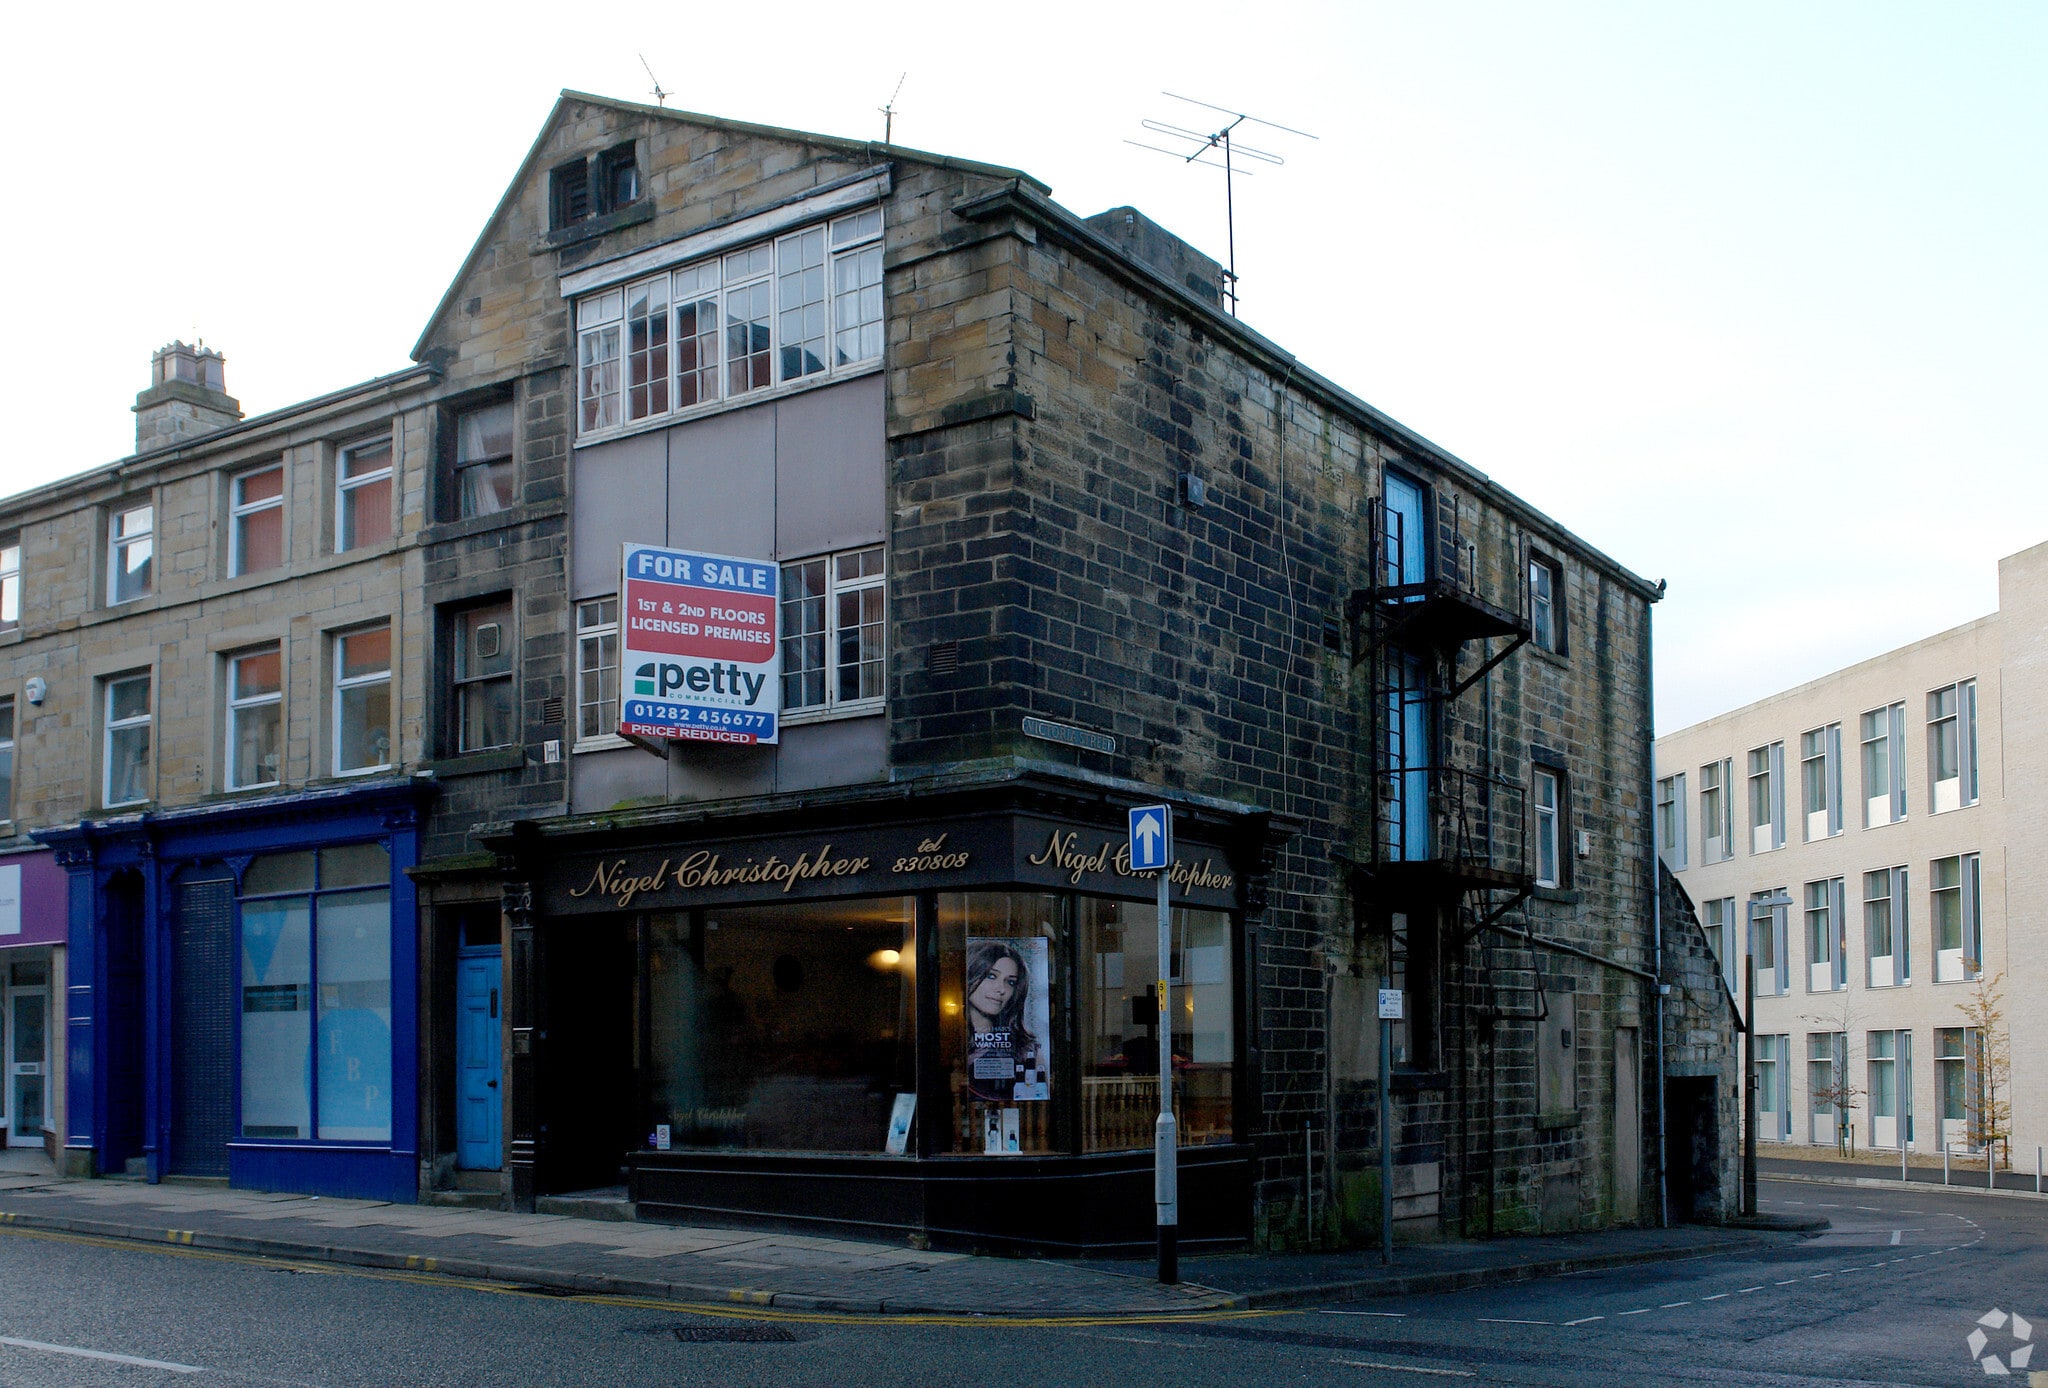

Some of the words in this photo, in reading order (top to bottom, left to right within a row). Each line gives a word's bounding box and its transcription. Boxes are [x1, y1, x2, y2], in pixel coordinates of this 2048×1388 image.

[638, 553, 691, 581] FOR
[702, 562, 767, 590] SALE
[637, 598, 657, 612] 1ST
[661, 601, 673, 614] &
[678, 603, 705, 618] 2ND
[710, 607, 765, 625] FLOORS
[631, 616, 699, 636] LICENSED
[704, 625, 771, 645] PREMISES
[659, 662, 766, 706] petty
[669, 692, 742, 705] COMMERCIAL
[634, 703, 690, 721] 01282
[698, 710, 766, 728] 456677
[673, 721, 728, 732] www.petty.co.uk
[631, 724, 676, 738] PRICE
[679, 727, 750, 744] REDUCED
[1027, 719, 1076, 742] VICTORIA
[1079, 732, 1113, 751] STREET
[917, 832, 948, 854] tel
[891, 852, 970, 874] 830808
[1030, 829, 1110, 885] Nigel
[570, 858, 669, 908] Nigel
[672, 844, 870, 893] Christopher
[974, 1032, 1011, 1042] MOST
[974, 1041, 1012, 1049] WANTED
